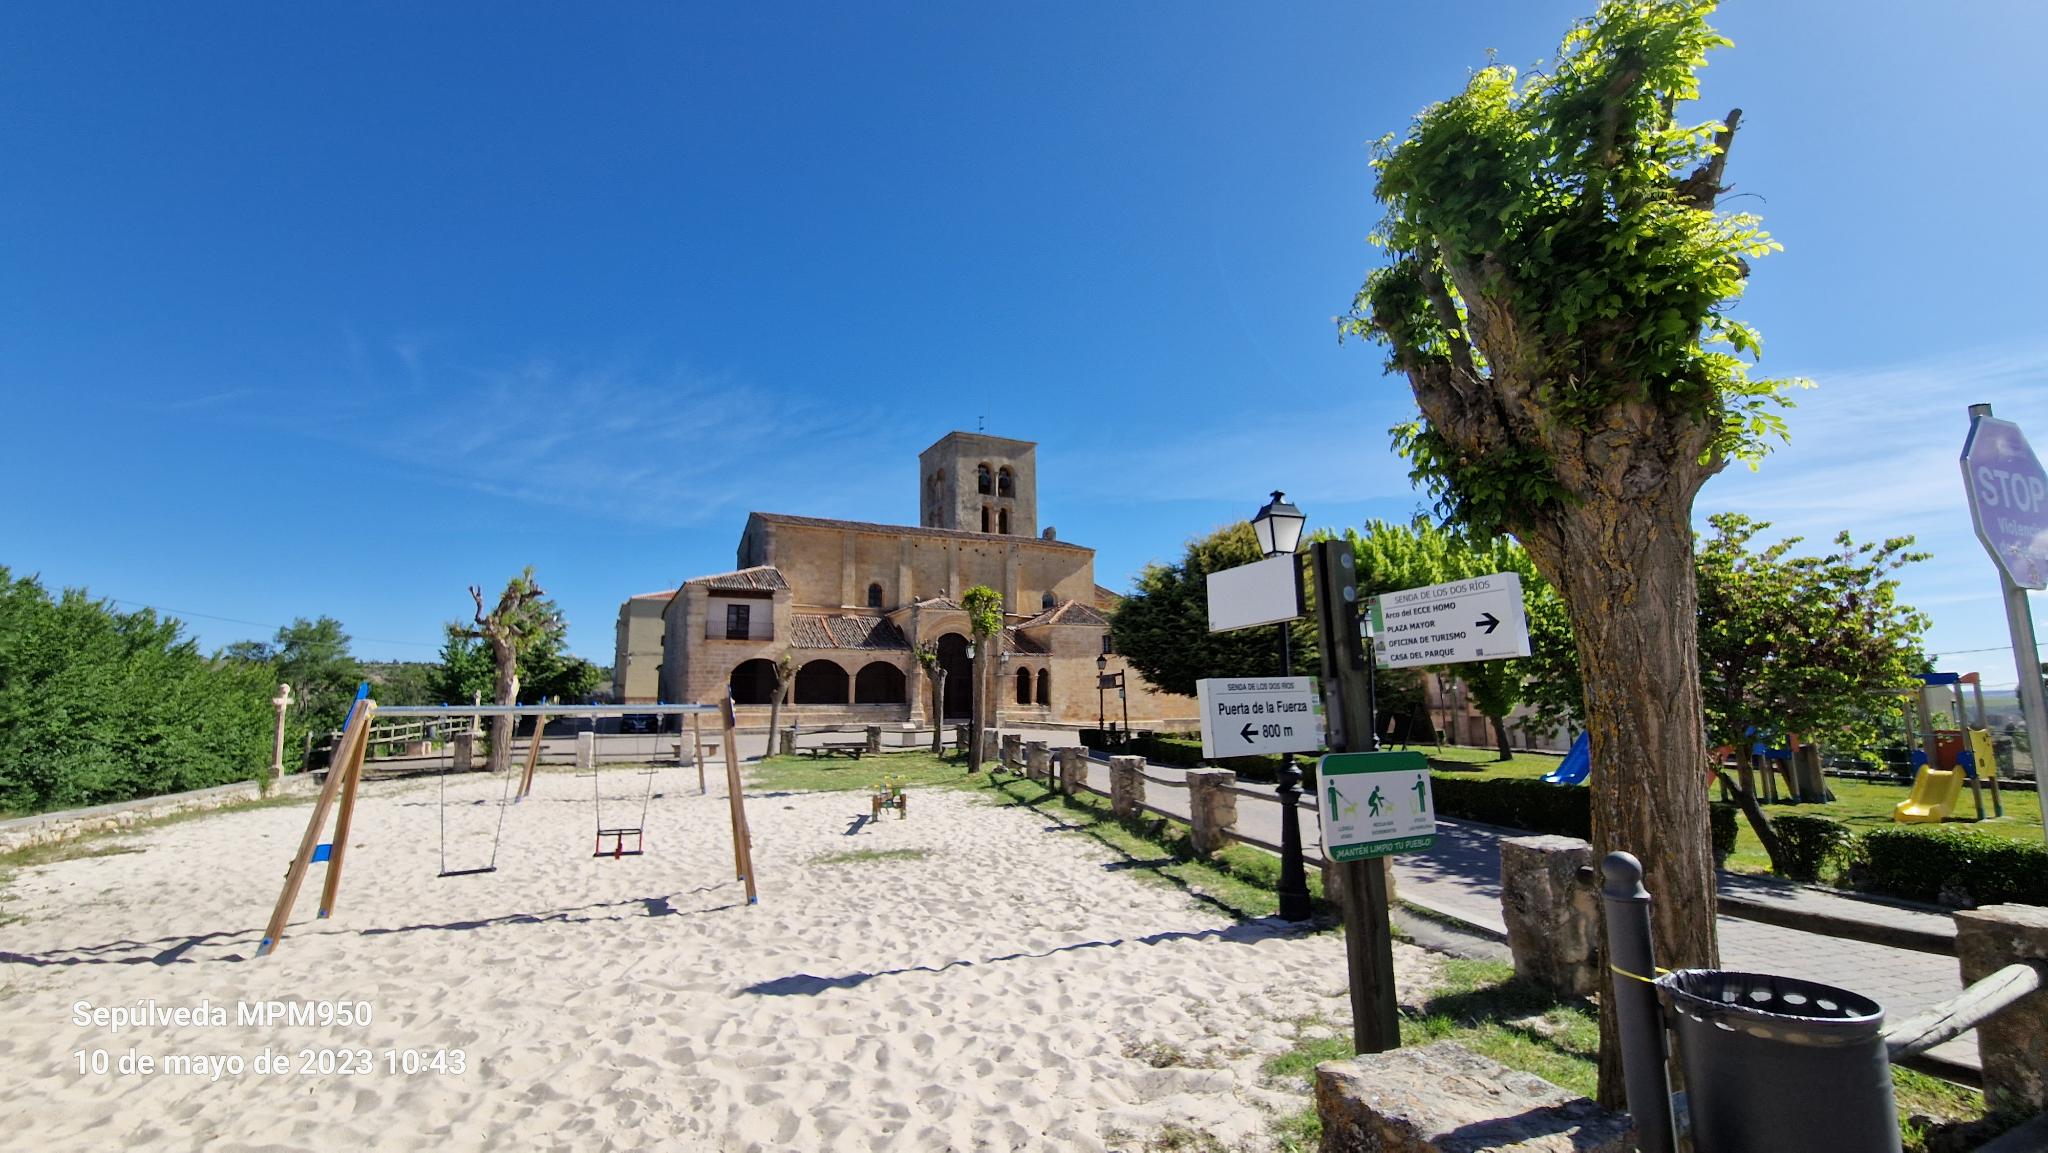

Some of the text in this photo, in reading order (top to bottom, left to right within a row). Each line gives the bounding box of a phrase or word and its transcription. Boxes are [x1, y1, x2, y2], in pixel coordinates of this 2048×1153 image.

[1978, 466, 2044, 513] STOP
[1394, 579, 1490, 604] SENDA DE LOS DOS RÍOS
[1385, 602, 1456, 619] Arco del ECCE HOMO
[1387, 620, 1436, 633] PLAZA MAYOR
[1388, 631, 1466, 648] OFICINA DE TURISMO
[1390, 648, 1455, 662] CASA DEL PARQUE
[1227, 683, 1247, 691] SENDA
[1256, 682, 1268, 690] LOS
[1269, 682, 1280, 690] DOS
[1218, 700, 1308, 716] Puerta de la Fuerza
[1262, 724, 1293, 738] 800 m
[1370, 842, 1393, 854] LIMPIO
[1395, 841, 1404, 850] TU
